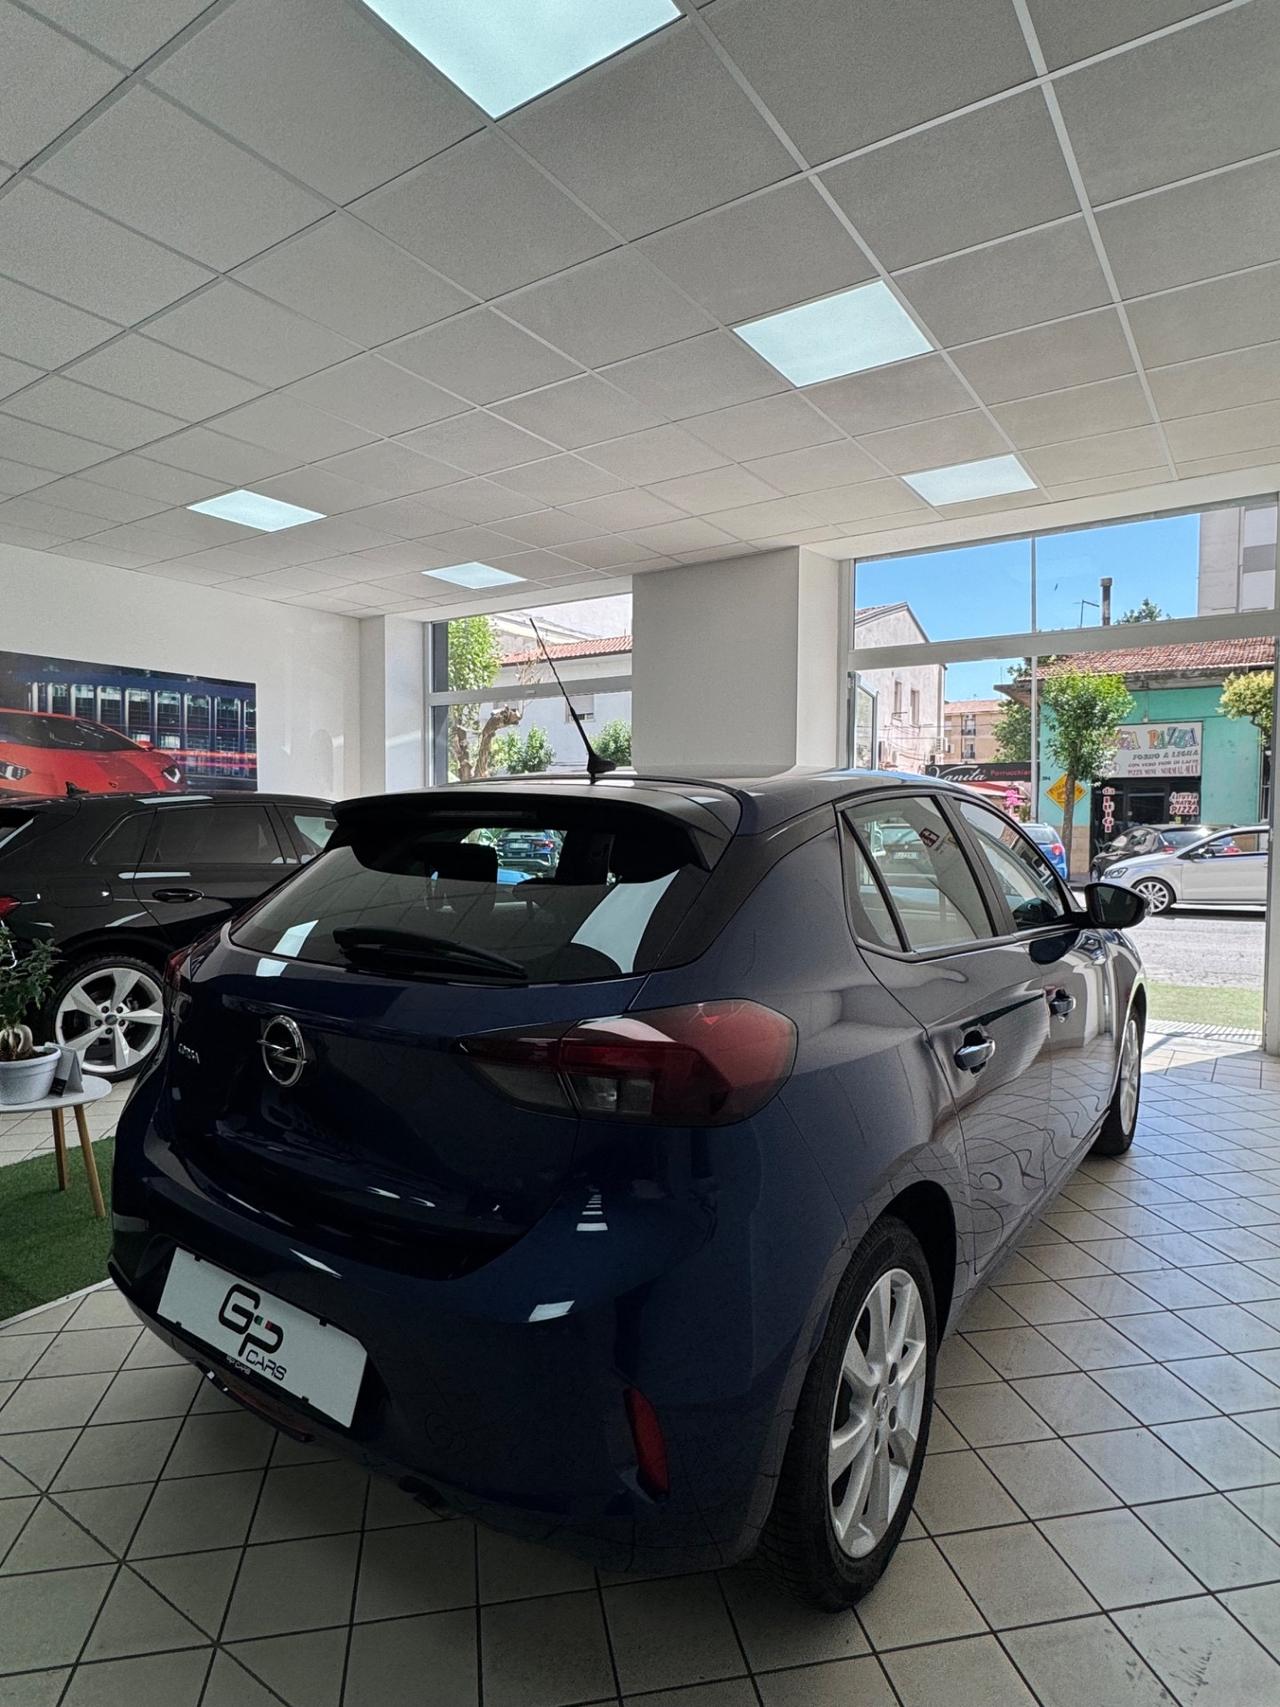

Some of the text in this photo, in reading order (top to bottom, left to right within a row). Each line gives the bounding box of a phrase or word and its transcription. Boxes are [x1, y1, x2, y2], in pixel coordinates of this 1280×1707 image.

[1147, 726, 1200, 750] PAZZA
[1171, 806, 1199, 814] PIZZA
[246, 1349, 288, 1382] CARS
